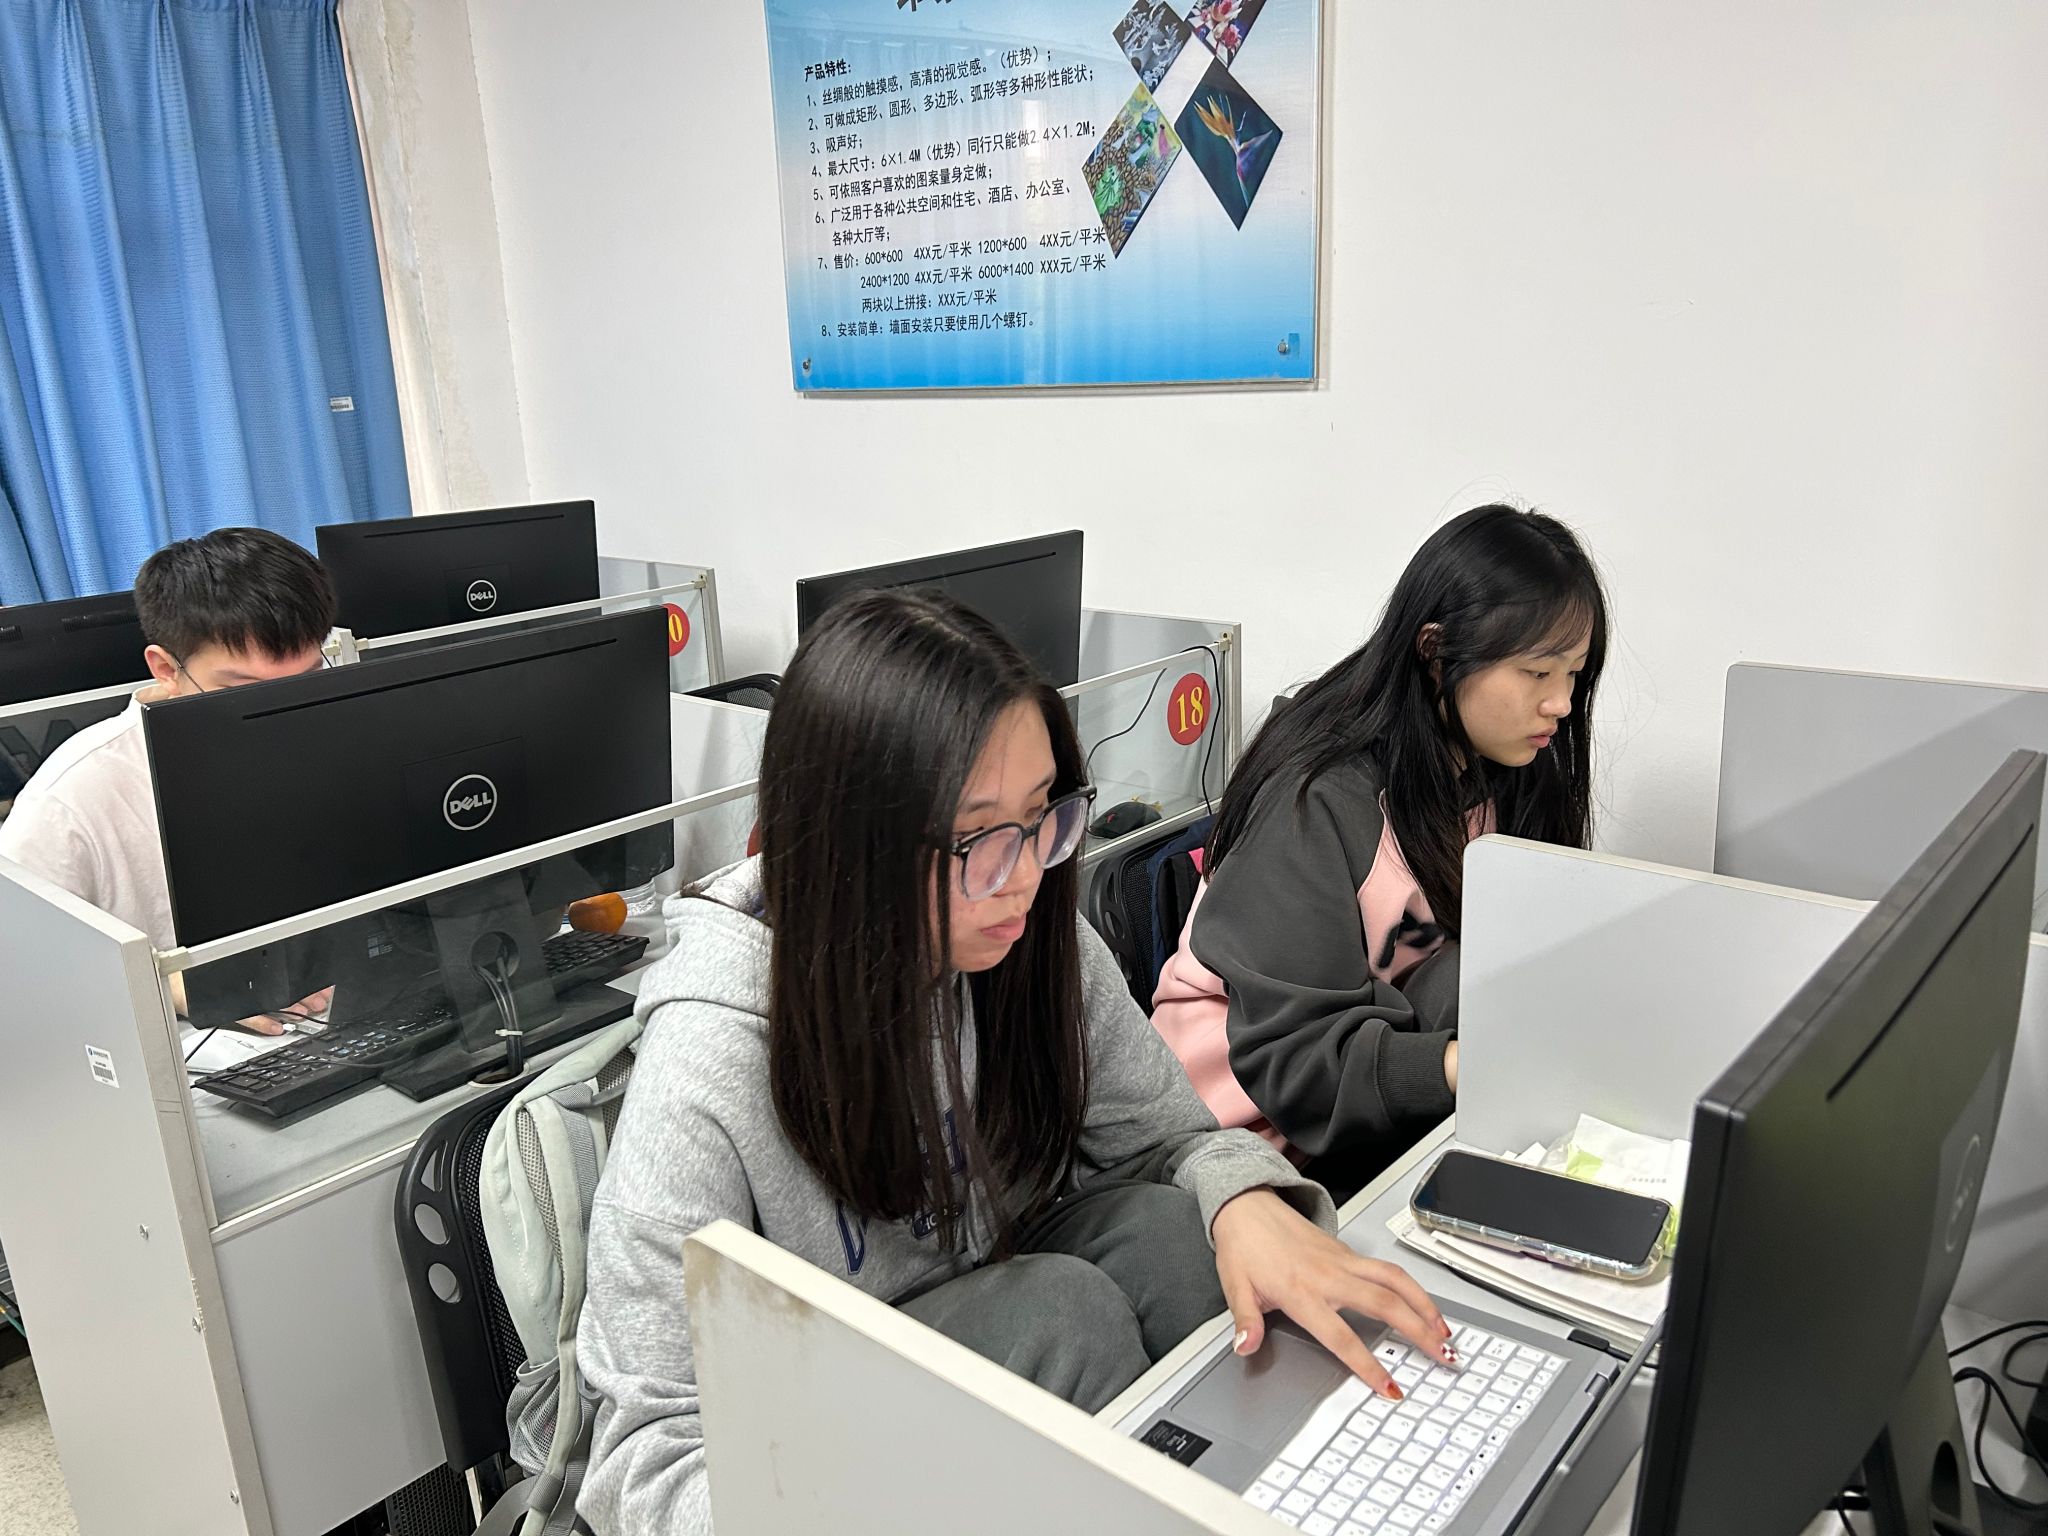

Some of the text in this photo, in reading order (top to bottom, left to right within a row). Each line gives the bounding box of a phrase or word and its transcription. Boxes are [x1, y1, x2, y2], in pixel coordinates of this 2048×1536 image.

[804, 58, 852, 82] 产品特性：
[810, 134, 863, 154] 3、吸声好；
[832, 225, 890, 247] 各种大厅等；
[470, 590, 494, 601] DELL
[668, 613, 683, 643] 0
[1176, 686, 1204, 734] 18
[449, 791, 492, 815] DELL
